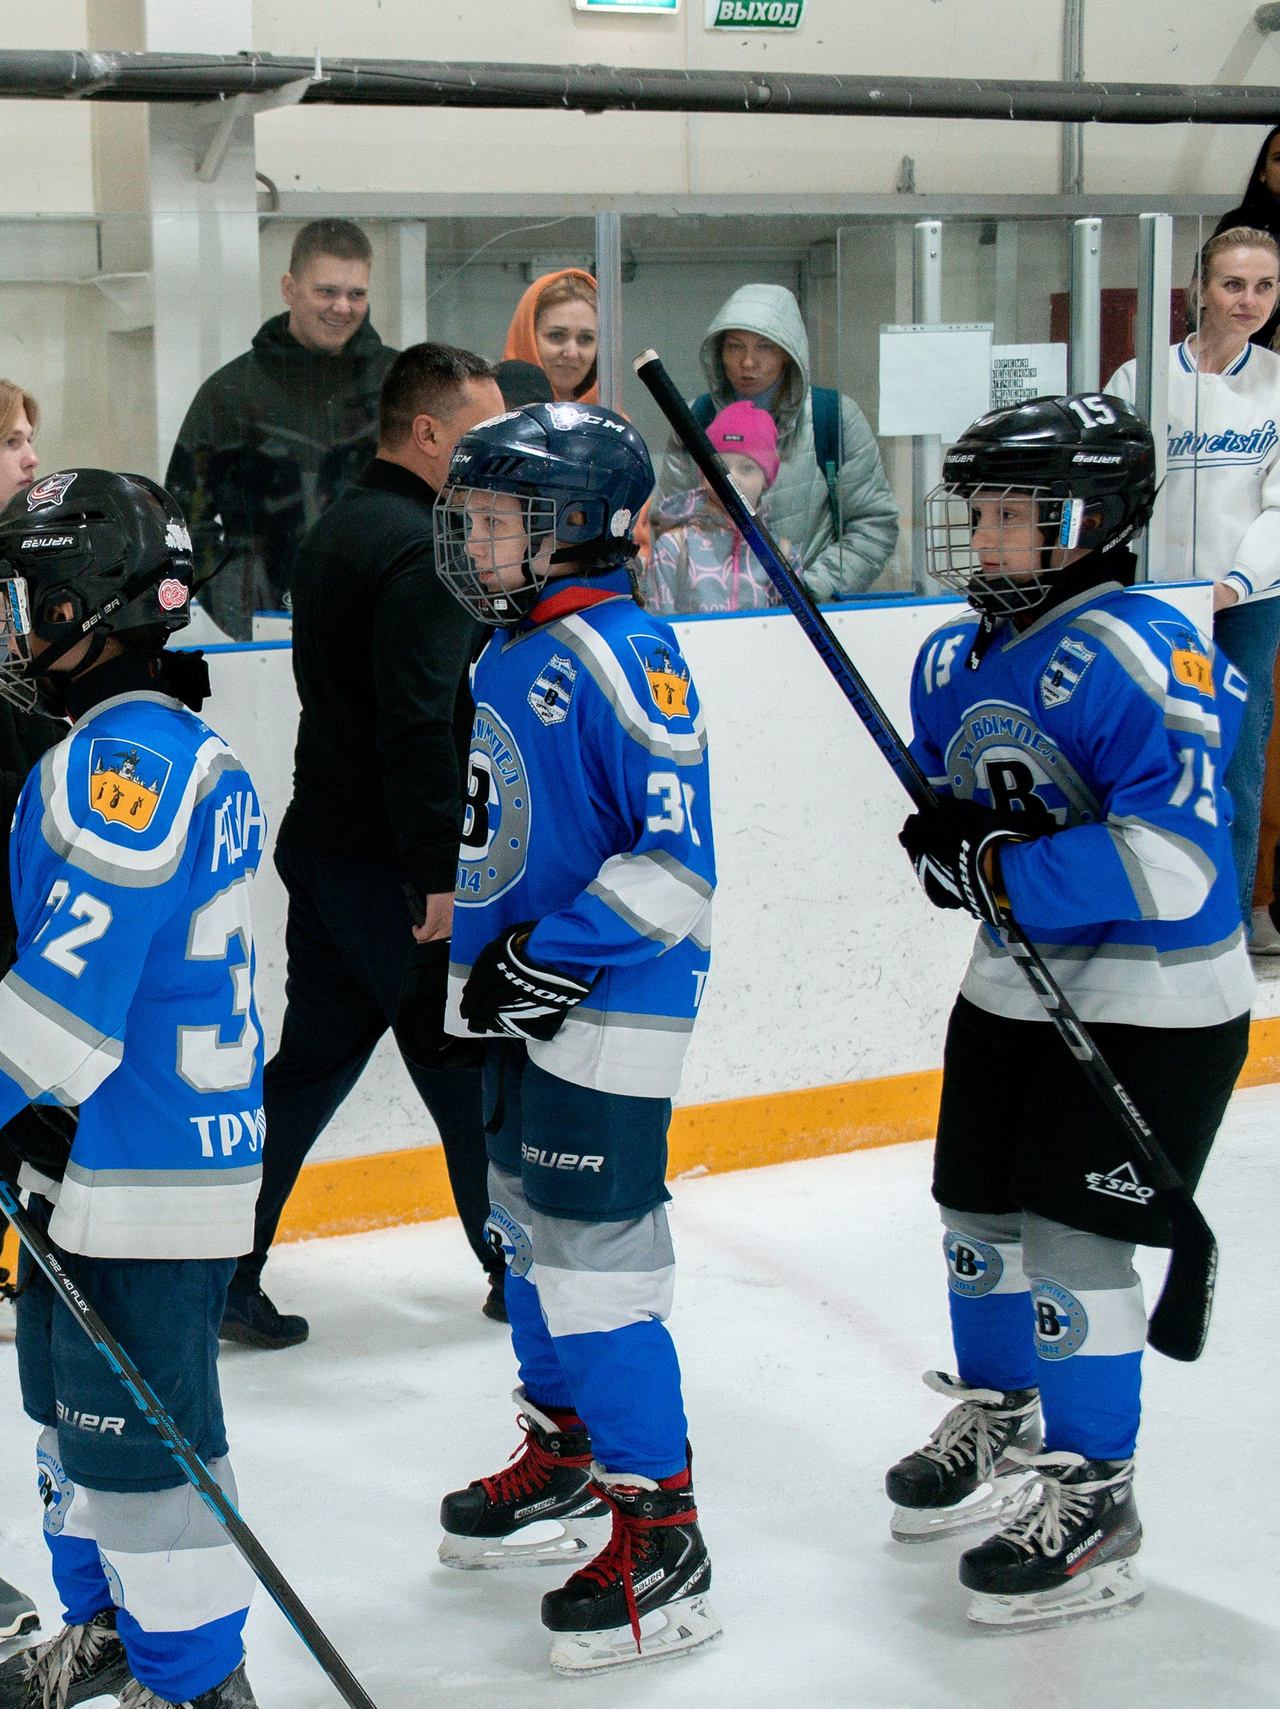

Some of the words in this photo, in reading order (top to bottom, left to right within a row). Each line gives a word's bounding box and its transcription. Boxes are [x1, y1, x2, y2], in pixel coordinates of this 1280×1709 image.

[719, 1, 800, 24] ВЫХОД
[992, 388, 1038, 399] ЖДЕНИЕ
[582, 415, 626, 433] CM
[1069, 396, 1118, 429] 15
[1167, 419, 1279, 458] niversity
[21, 536, 74, 549] BAUER
[71, 1287, 90, 1314] FLEX
[56, 1399, 126, 1436] AUER
[1066, 1529, 1103, 1565] BAUER
